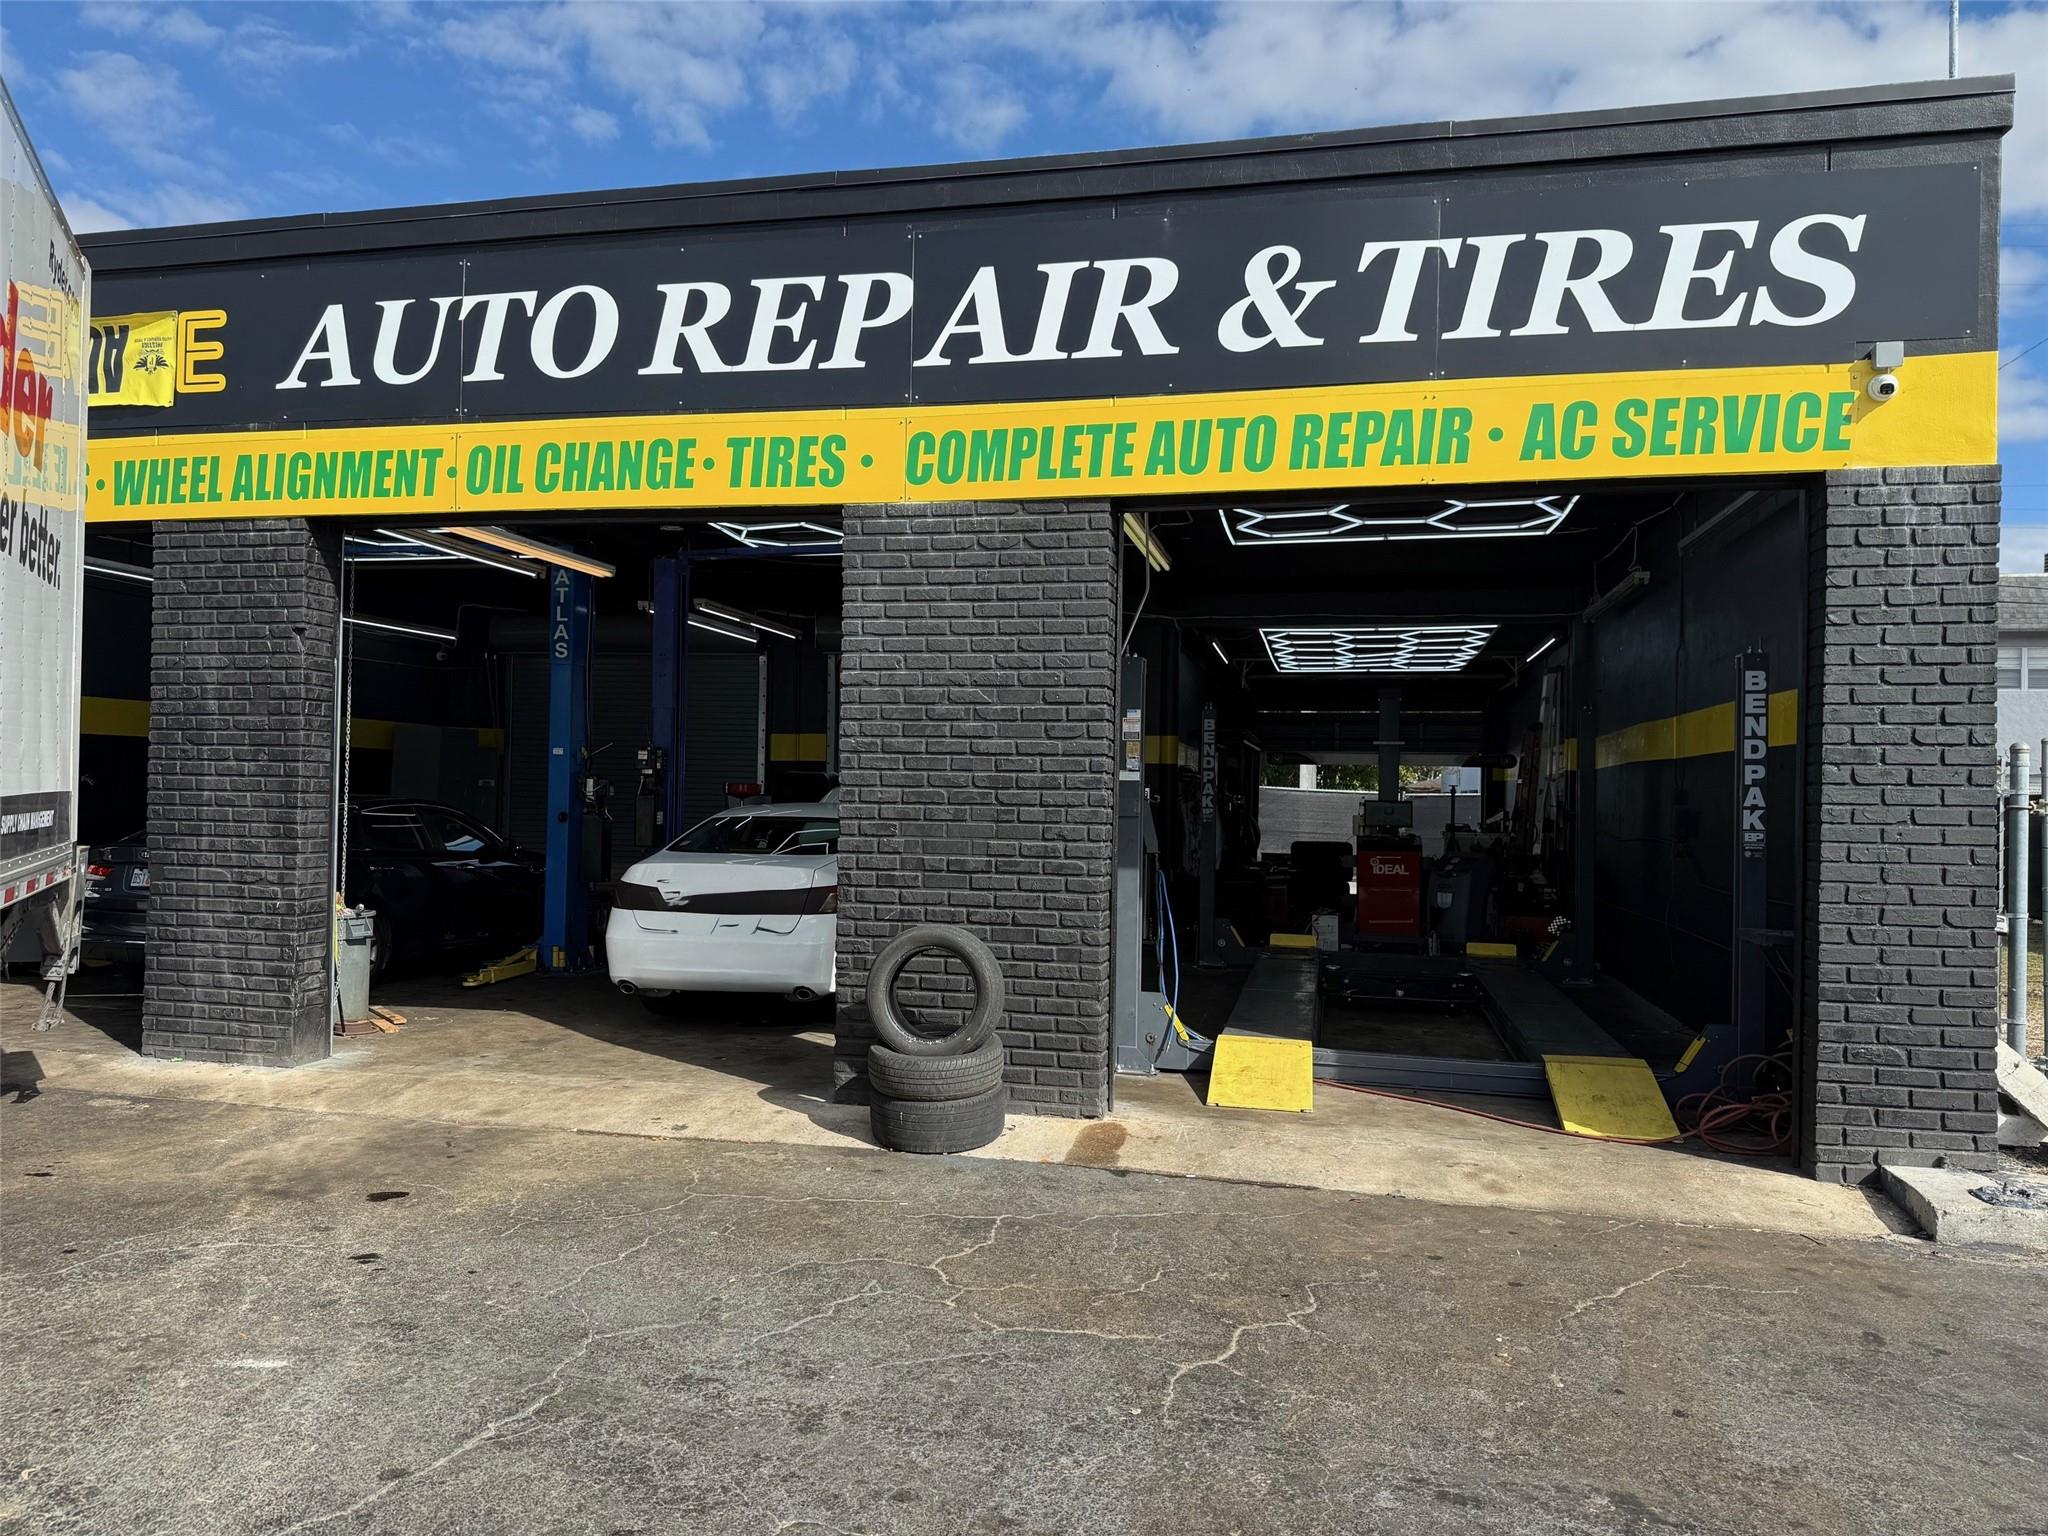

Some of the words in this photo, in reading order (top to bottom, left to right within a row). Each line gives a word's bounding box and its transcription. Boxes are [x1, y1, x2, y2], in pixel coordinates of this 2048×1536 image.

[276, 285, 619, 390] AUTO
[637, 257, 1180, 375] REPAIR
[1217, 245, 1337, 352] &
[1357, 214, 1868, 344] TIRES
[114, 456, 222, 506] WHEEL
[231, 448, 444, 501] ALIGNMENT
[467, 445, 523, 495] OIL
[535, 438, 696, 493] CHANGE
[727, 434, 846, 488] TIRES
[906, 422, 1137, 485] COMPLETE
[1145, 416, 1277, 476] AUTO
[1289, 407, 1473, 470] REPAIR
[1520, 401, 1598, 461] AC
[1612, 392, 1855, 458] SERVICE
[554, 569, 570, 658] ATLAS
[1202, 718, 1215, 807] BENDPAK
[1743, 670, 1767, 831] BENDPAK
